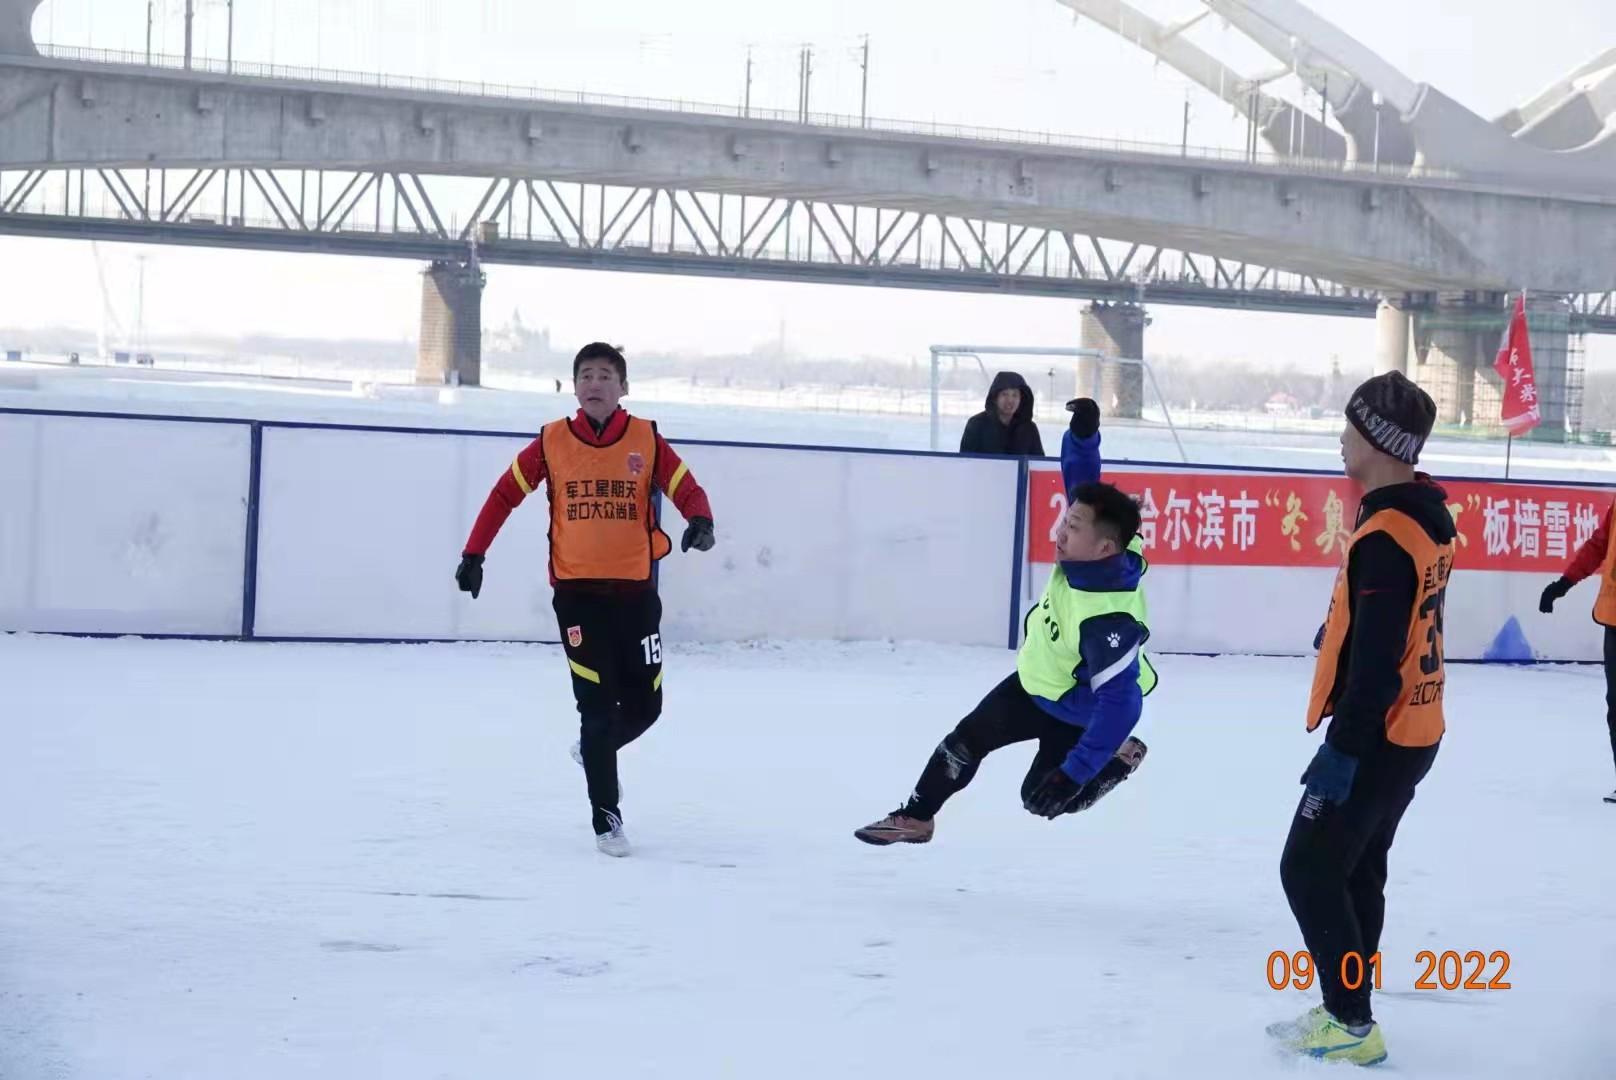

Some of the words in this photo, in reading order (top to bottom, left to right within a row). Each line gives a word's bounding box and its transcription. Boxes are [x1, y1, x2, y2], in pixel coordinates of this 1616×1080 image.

[1352, 397, 1422, 463] FASHION
[565, 479, 637, 499] 军工星期天
[641, 633, 662, 665] 15
